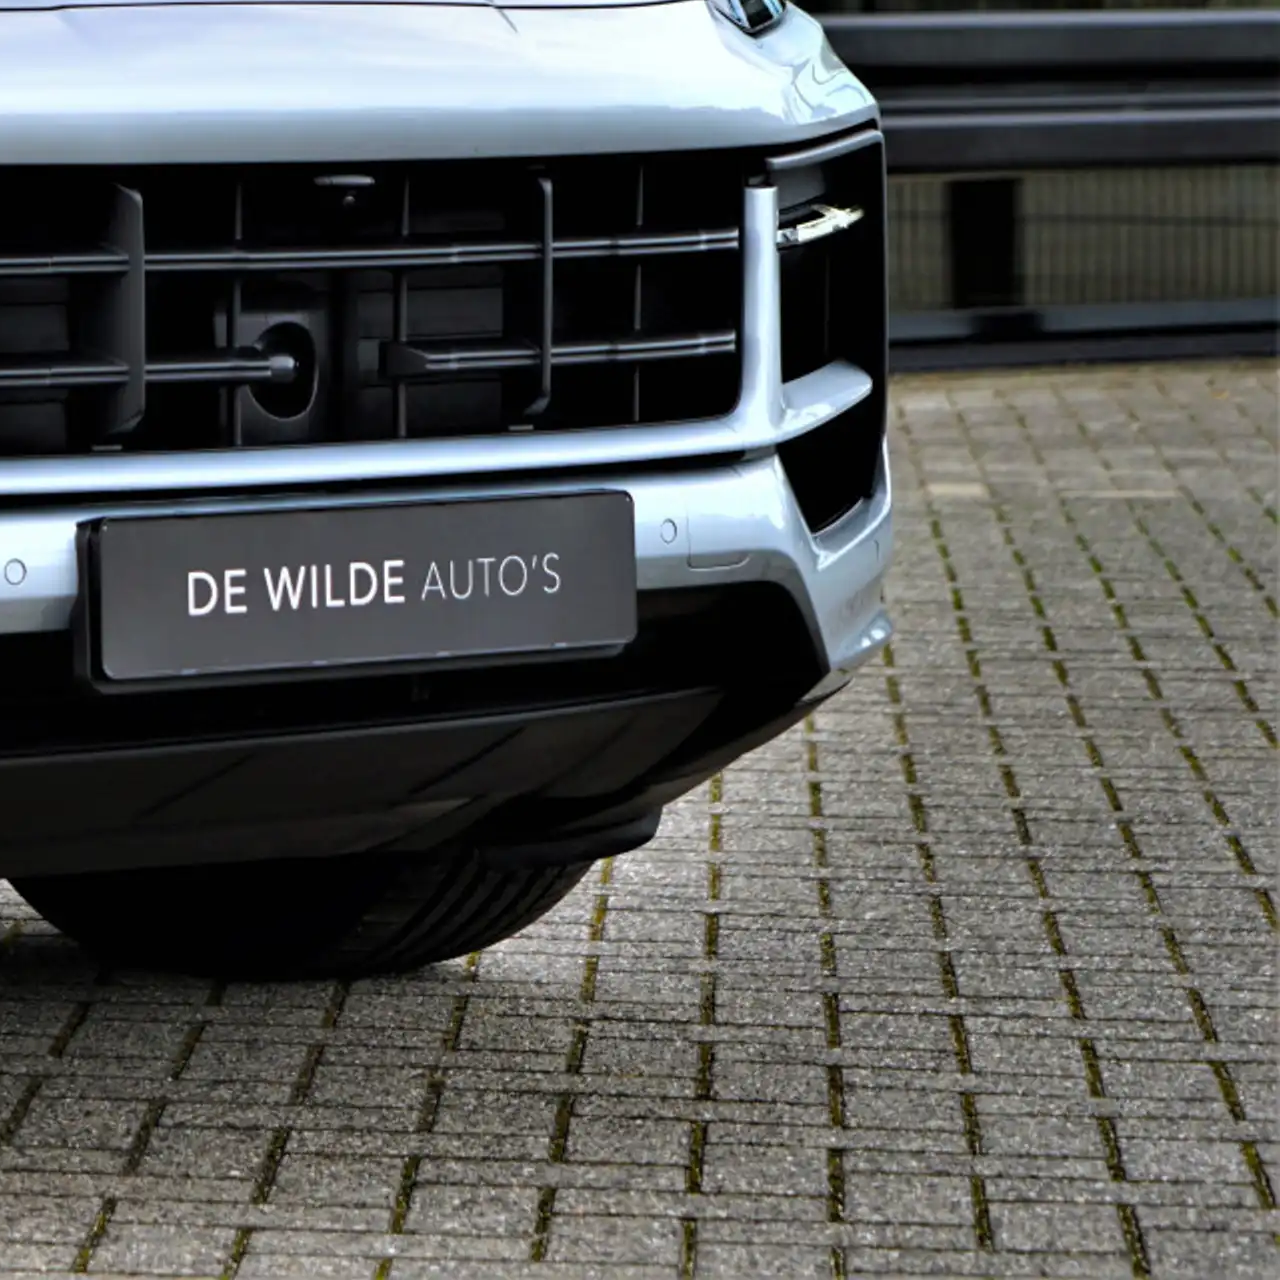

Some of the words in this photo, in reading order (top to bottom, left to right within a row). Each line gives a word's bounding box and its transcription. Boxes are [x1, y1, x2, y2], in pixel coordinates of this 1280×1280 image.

[187, 568, 247, 616] DE
[263, 559, 406, 610] WILDE
[421, 552, 562, 601] AUTO'S
